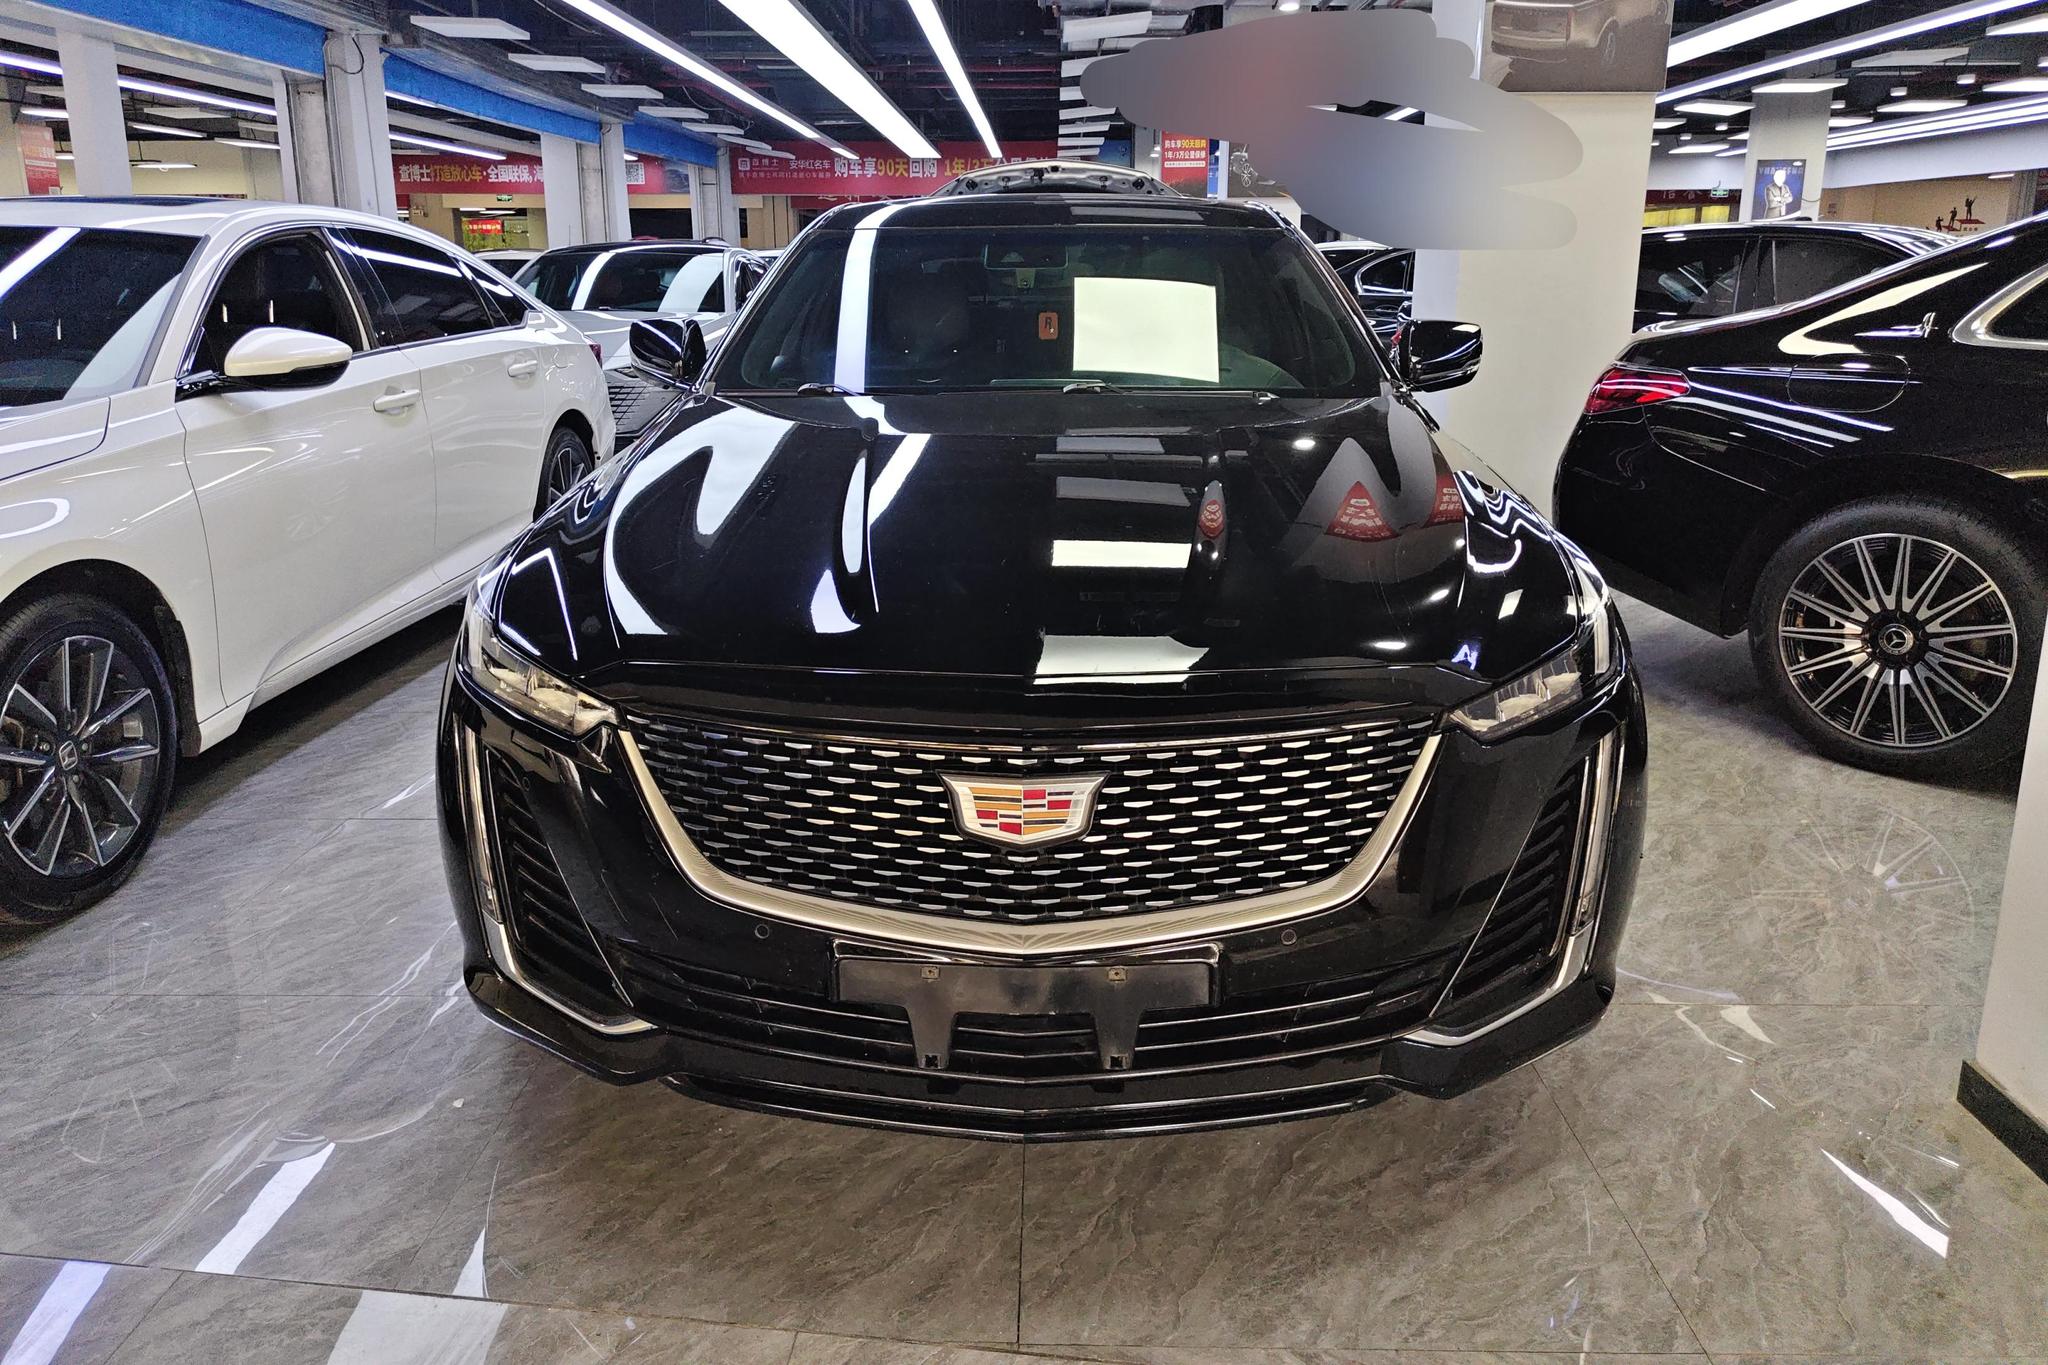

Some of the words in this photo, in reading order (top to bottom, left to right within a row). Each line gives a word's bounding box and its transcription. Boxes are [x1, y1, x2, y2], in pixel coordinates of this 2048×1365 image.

[834, 157, 938, 177] 购车享90天回购
